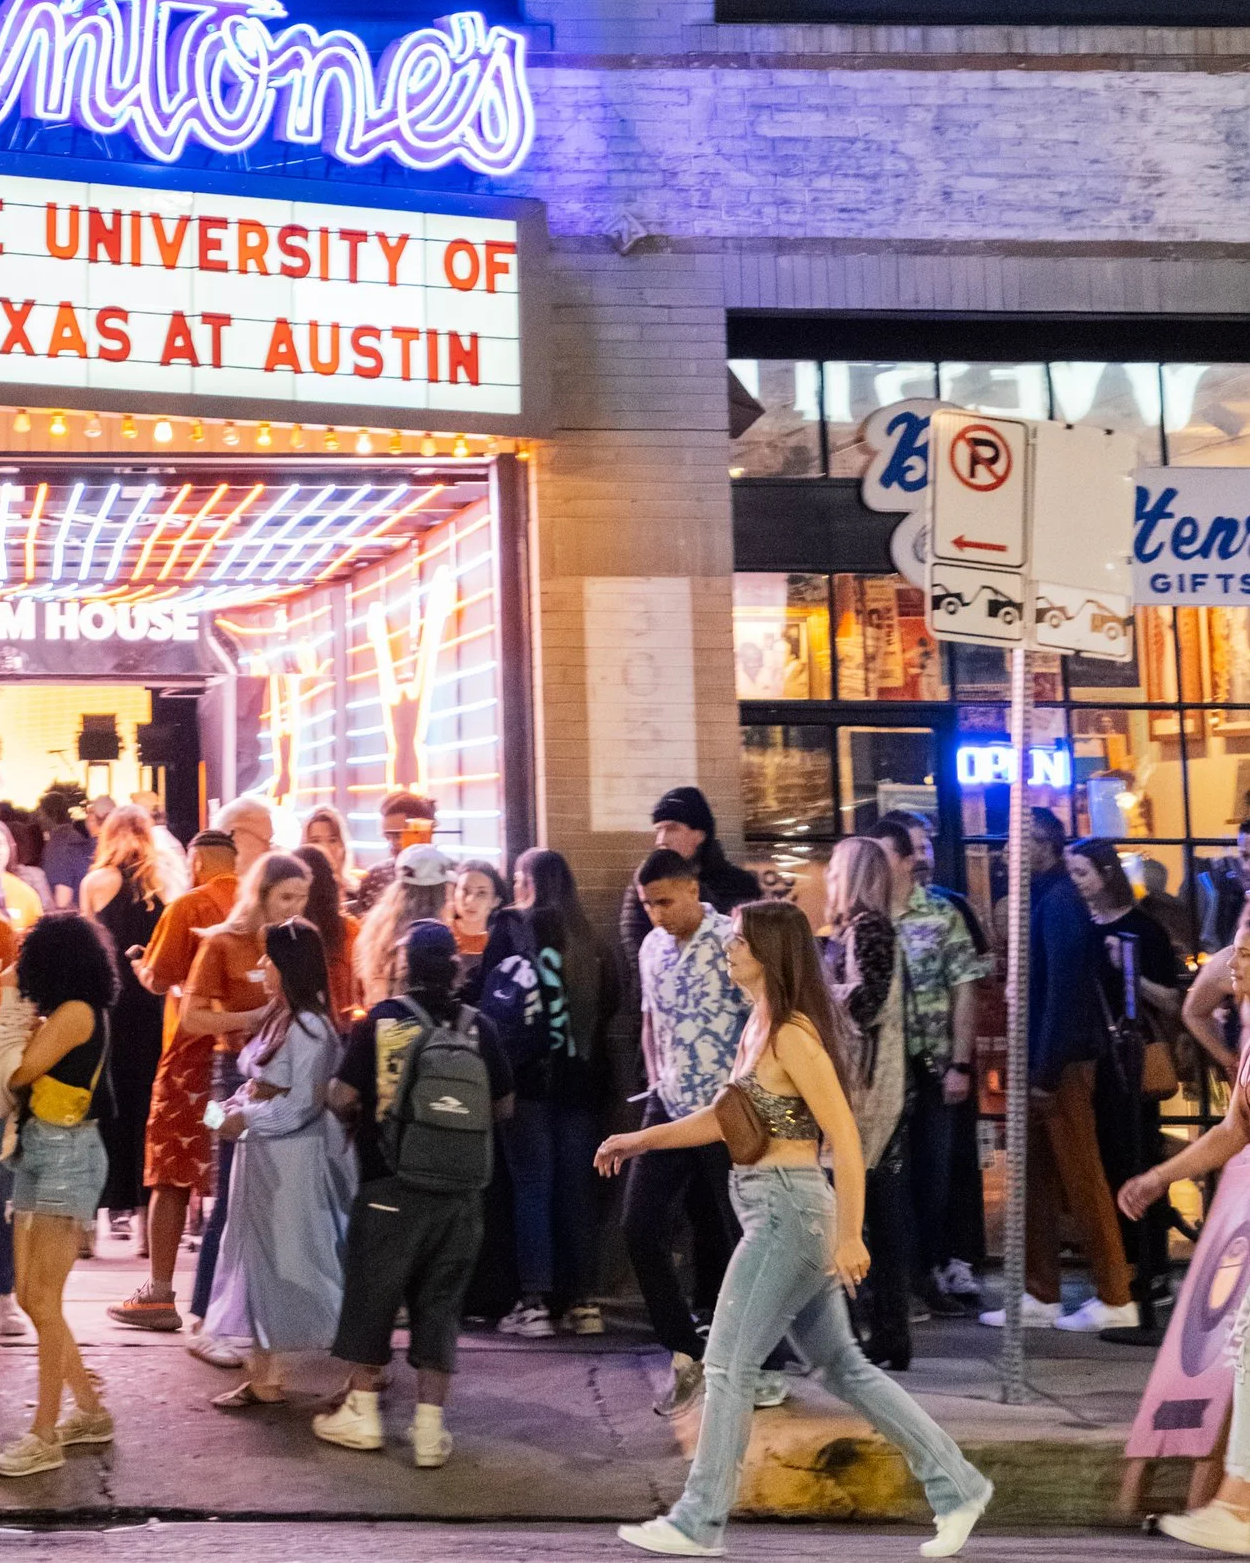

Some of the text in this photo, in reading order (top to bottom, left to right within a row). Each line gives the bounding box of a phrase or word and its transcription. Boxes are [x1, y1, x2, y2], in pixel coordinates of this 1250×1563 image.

[45, 203, 410, 287] UNIVERSITY
[443, 239, 518, 295] OF
[160, 312, 232, 369] AT
[263, 317, 481, 387] AUSTIN
[1135, 485, 1250, 564] Hen
[44, 601, 200, 641] HOUSE
[956, 746, 1071, 788] OPN
